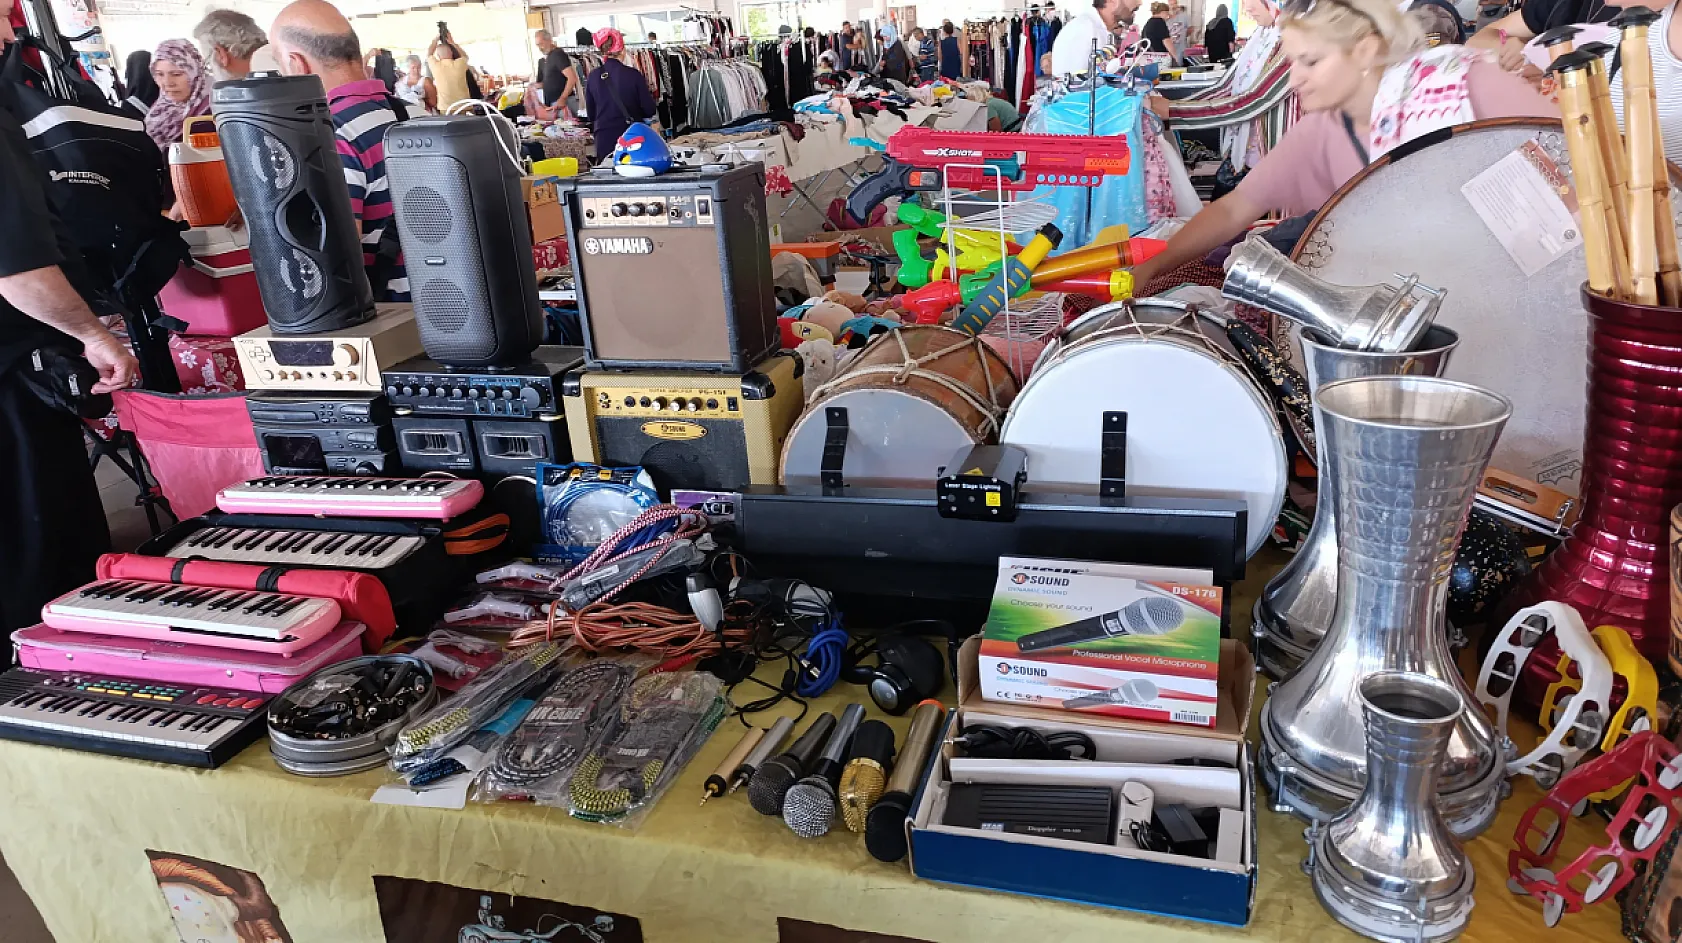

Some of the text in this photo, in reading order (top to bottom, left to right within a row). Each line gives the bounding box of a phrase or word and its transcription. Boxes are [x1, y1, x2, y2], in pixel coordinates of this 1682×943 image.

[598, 238, 649, 253] YAMAHA
[1029, 575, 1070, 587] SOUND
[1007, 586, 1068, 596] DYNAMIC SOUND
[1010, 598, 1093, 612] Choose your sound
[1072, 649, 1207, 670] Professional Vocal Microphone
[1012, 666, 1048, 677] SOUND
[547, 707, 586, 720] CABLE
[1027, 825, 1057, 834] Doppler
